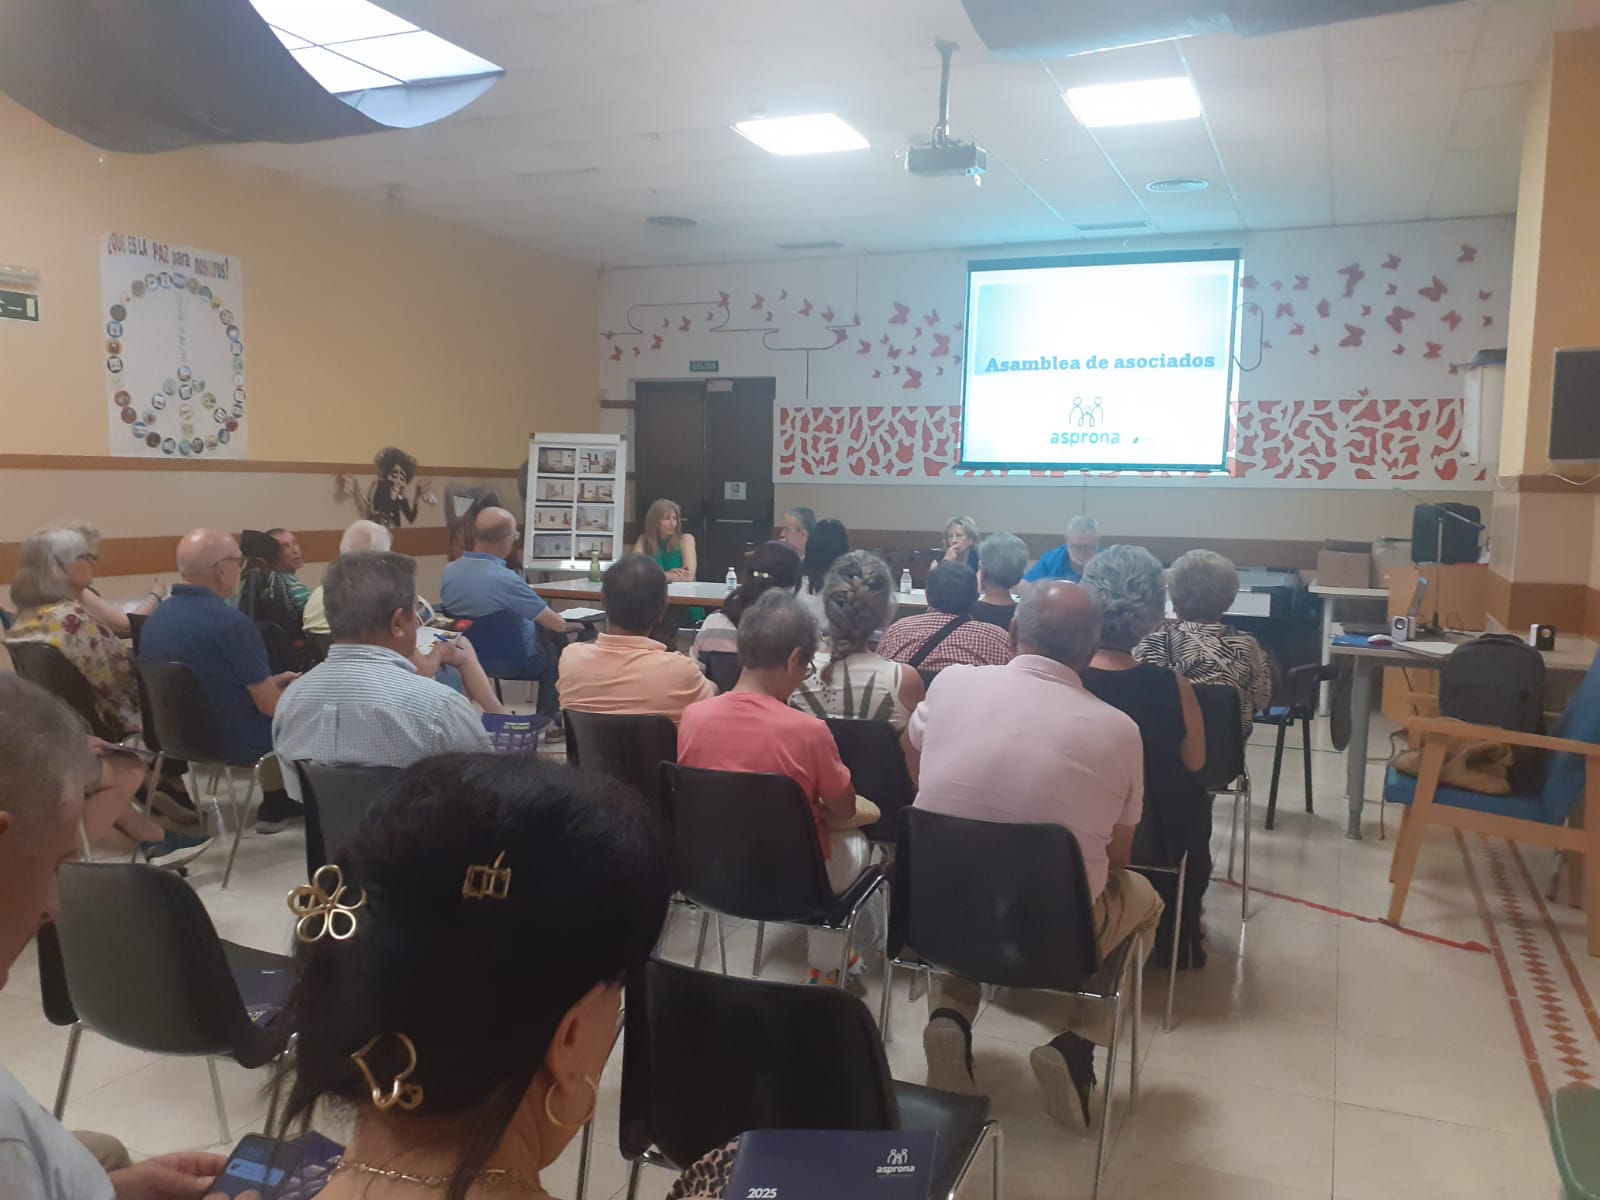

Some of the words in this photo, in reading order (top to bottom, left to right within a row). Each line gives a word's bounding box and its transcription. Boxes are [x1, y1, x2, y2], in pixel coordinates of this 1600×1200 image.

[138, 238, 148, 256] LA
[152, 242, 170, 264] PAZ
[985, 355, 1081, 373] Asamblea
[1086, 355, 1109, 369] de
[1114, 352, 1215, 369] asociados
[1050, 430, 1120, 447] asprona
[876, 1164, 915, 1175] asprona
[747, 1188, 777, 1199] 2025
